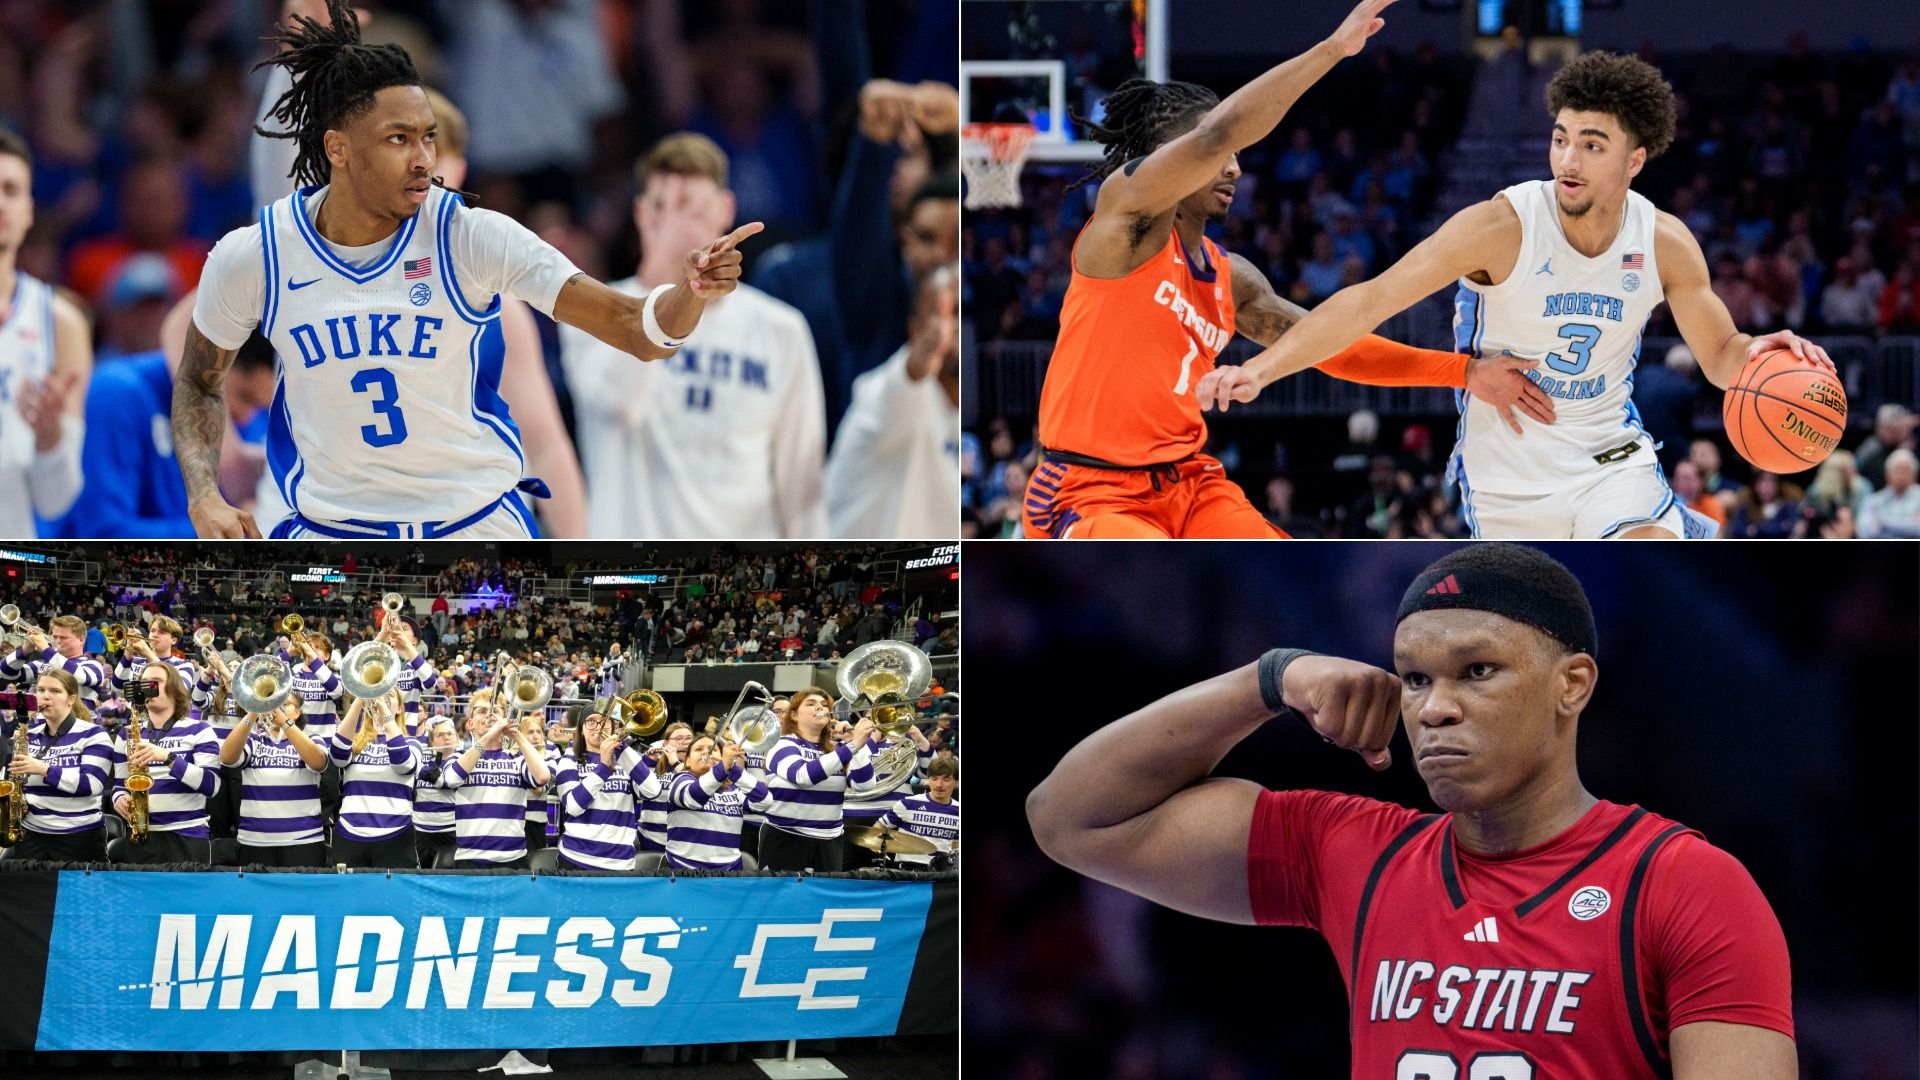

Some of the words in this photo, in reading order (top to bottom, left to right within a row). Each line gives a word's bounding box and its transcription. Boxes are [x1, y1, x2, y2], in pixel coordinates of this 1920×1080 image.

[1543, 292, 1623, 321] NORTH
[289, 314, 443, 368] DUKE
[1545, 323, 1602, 375] 3
[1173, 336, 1199, 396] 1
[1502, 349, 1606, 400] ROLINA
[350, 367, 408, 448] 3
[1803, 390, 1847, 417] EGACY
[906, 555, 953, 569] SECOND
[932, 545, 959, 557] FIRS
[291, 574, 323, 582] SECOND
[308, 567, 333, 575] FIRST
[475, 761, 489, 769] GH
[913, 813, 936, 823] HIGH
[1576, 898, 1606, 906] ACC
[150, 914, 681, 1009] MADNESS
[1370, 958, 1436, 1023] NC
[1432, 964, 1594, 1034] STATE
